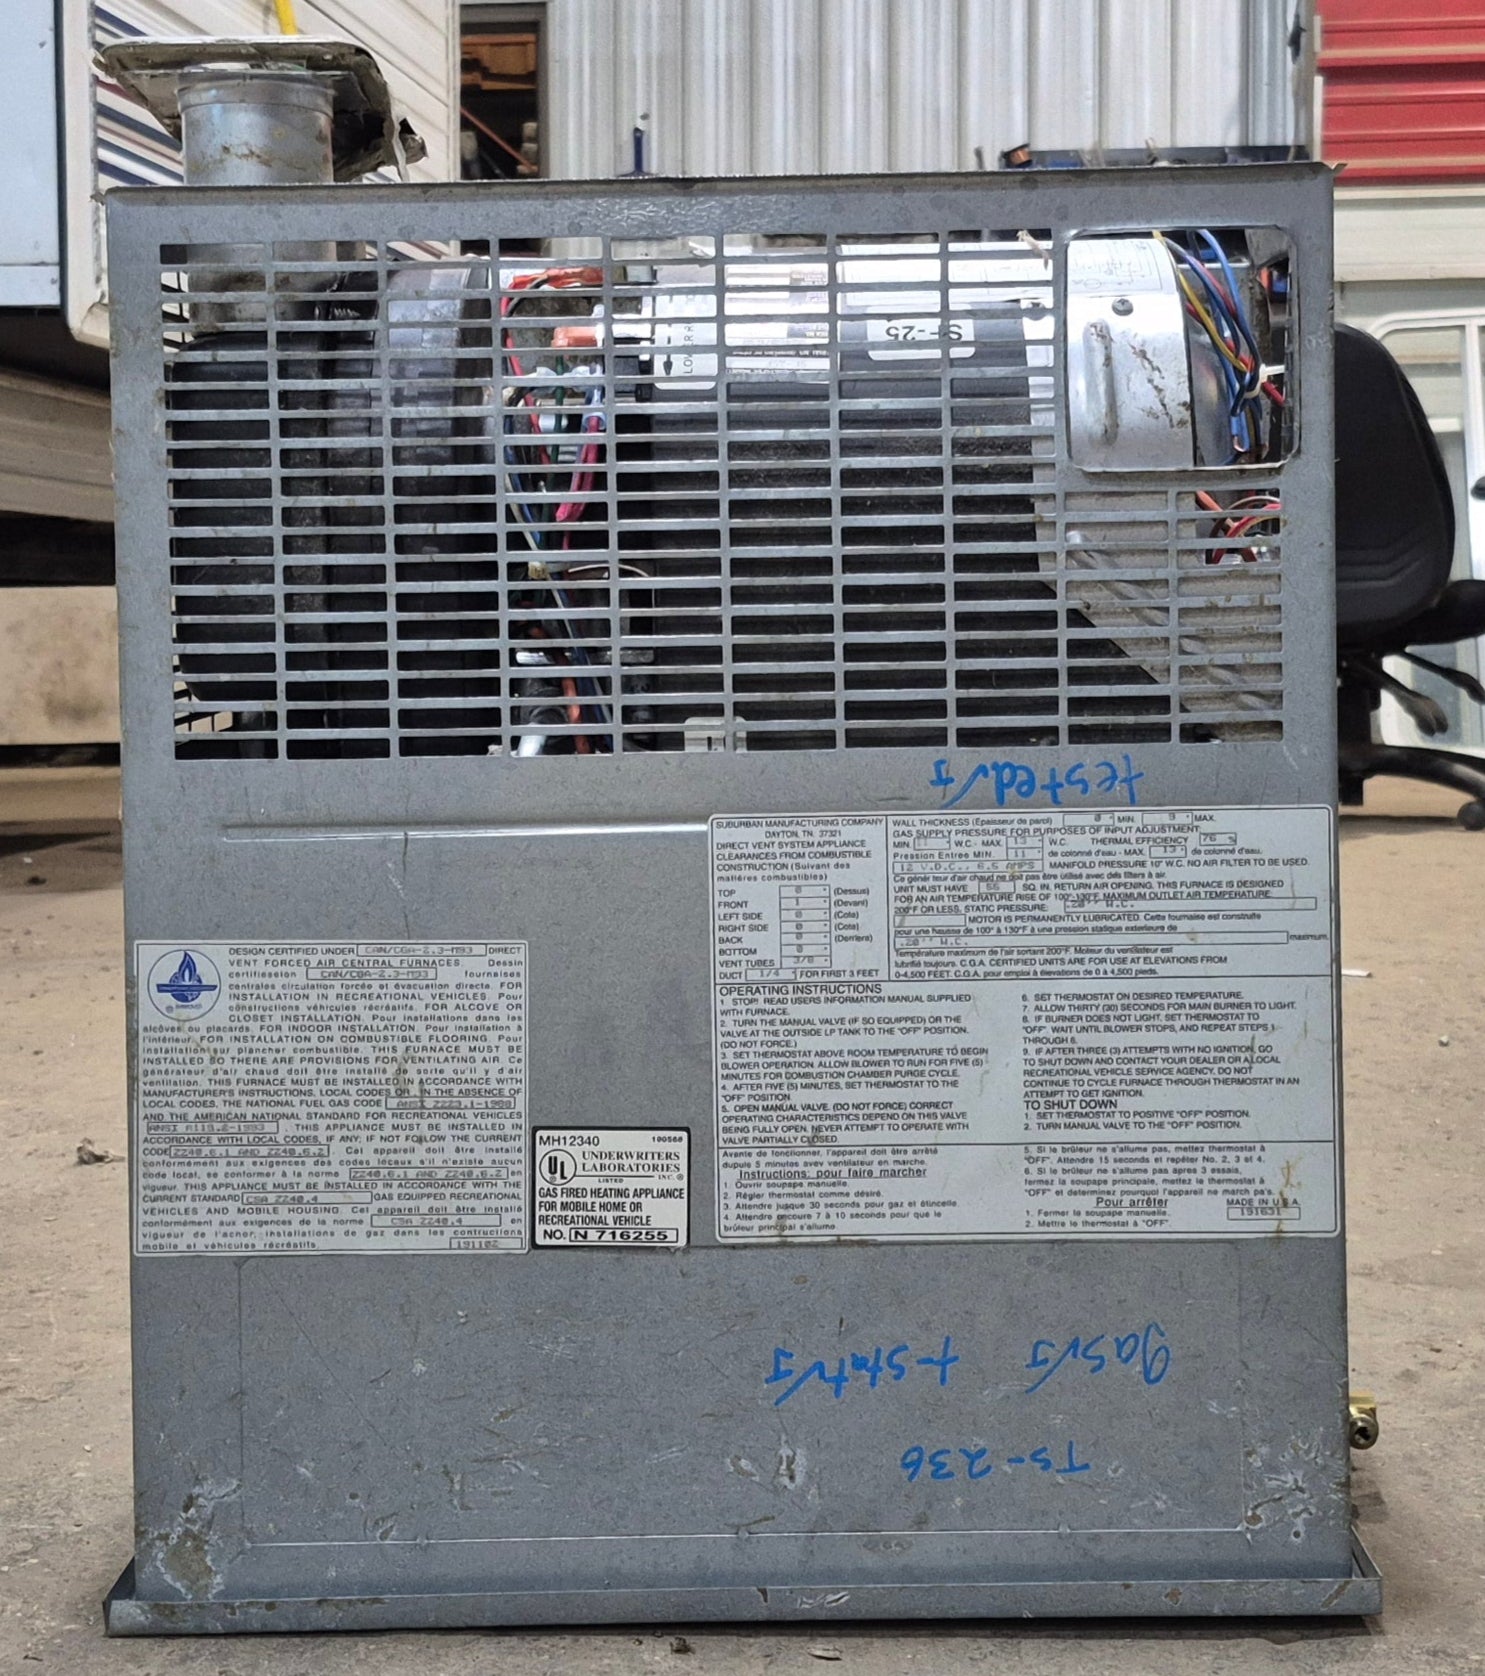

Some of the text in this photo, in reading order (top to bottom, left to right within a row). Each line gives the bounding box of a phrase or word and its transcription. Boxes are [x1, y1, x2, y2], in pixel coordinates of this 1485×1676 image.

[991, 754, 1144, 805] tested
[716, 818, 883, 829] SUBURBAN MANUFACTURING COMPANY
[819, 829, 841, 837] 37321
[716, 839, 866, 850] DIRECT VENT SYSTEM APPLIANCE
[1090, 836, 1188, 846] THERMAL EFFICIENCY
[716, 850, 872, 860] CLEARANCES FROM COMBUSTIBLE
[717, 889, 736, 897] TOP
[717, 900, 748, 908] FRONT
[717, 912, 763, 921] LEFT SIDE
[717, 923, 769, 932] RIGHT SIDE
[718, 936, 743, 944] BACK
[228, 947, 265, 955] DESIGN
[267, 947, 318, 955] CERTIFIED
[320, 947, 356, 955] UNDER
[718, 947, 757, 955] BOTTOM
[229, 959, 258, 967] VENT
[264, 959, 311, 968] FORCED
[316, 959, 336, 968] AIR
[342, 959, 394, 968] CENTRAL
[718, 959, 775, 969] VENT TUBES
[718, 971, 743, 979] DUCT
[799, 970, 819, 978] FOR
[820, 969, 846, 977] FIRST
[849, 969, 854, 977] 3
[856, 968, 879, 977] FEET
[719, 983, 882, 996] OPERATING INSTRUCTIONS
[228, 992, 309, 1000] INSTALLATION
[335, 992, 422, 1000] RECREATIONAL
[763, 997, 788, 1005] READ
[790, 996, 821, 1004] USERS
[823, 995, 885, 1004] INFORMATION
[926, 994, 972, 1002] SUPPLIED
[1034, 993, 1051, 1001] SET
[1054, 993, 1113, 1001] THERMOSTAT
[1116, 992, 1130, 1000] ON
[1132, 992, 1172, 1000] DESIRED
[1034, 1004, 1065, 1012] ALLOW
[1068, 1003, 1100, 1011] THIRTY
[1102, 1004, 1118, 1012] (30)
[1120, 1003, 1165, 1011] SECONDS
[1166, 1002, 1186, 1010] FOR
[1188, 1002, 1211, 1010] MAIN
[1213, 1002, 1252, 1010] BURNER
[1254, 1001, 1266, 1009] TO
[719, 1008, 743, 1016] WITH
[1022, 1036, 1068, 1044] THROUGH
[142, 1100, 174, 1108] LOCAL
[222, 1099, 241, 1107] THE
[246, 1099, 294, 1107] NATIONAL
[299, 1099, 324, 1107] FUEL
[328, 1099, 350, 1107] GAS
[353, 1099, 382, 1107] CODE
[1023, 1099, 1117, 1109] TO SHUT DOWN
[142, 1111, 522, 1122] AND THE AMERICAN NATIONAL STANDARD FOR RECREATIONAL VEHICLES
[294, 1123, 318, 1131] THIS
[325, 1123, 384, 1131] APPLIANCE
[391, 1123, 420, 1131] MUST
[427, 1123, 440, 1131] BE
[448, 1122, 505, 1130] INSTALLED
[538, 1135, 600, 1146] MH12340
[582, 1150, 680, 1160] UNDERWRITERS
[548, 1156, 568, 1180] UL
[582, 1162, 680, 1172] LABORATORIES
[816, 1170, 842, 1180] pour
[848, 1168, 874, 1178] faire
[880, 1168, 927, 1178] marcher
[142, 1194, 186, 1202] CURRENT
[190, 1194, 243, 1202] STANDARD
[397, 1192, 446, 1200] EQUIPPED
[449, 1192, 522, 1200] RECREATIONAL
[538, 1187, 684, 1199] GAS FIRED HEATING APPLIANCE
[538, 1201, 643, 1212] FOR MOBILE HOME OR
[1096, 1198, 1123, 1207] Pour
[1226, 1198, 1269, 1208] MADE IN
[142, 1207, 198, 1215] VEHICLES
[538, 1215, 652, 1226] RECREATIONAL VEHICLE
[543, 1230, 668, 1240] NO. N 716255
[1081, 1321, 1170, 1385] gas
